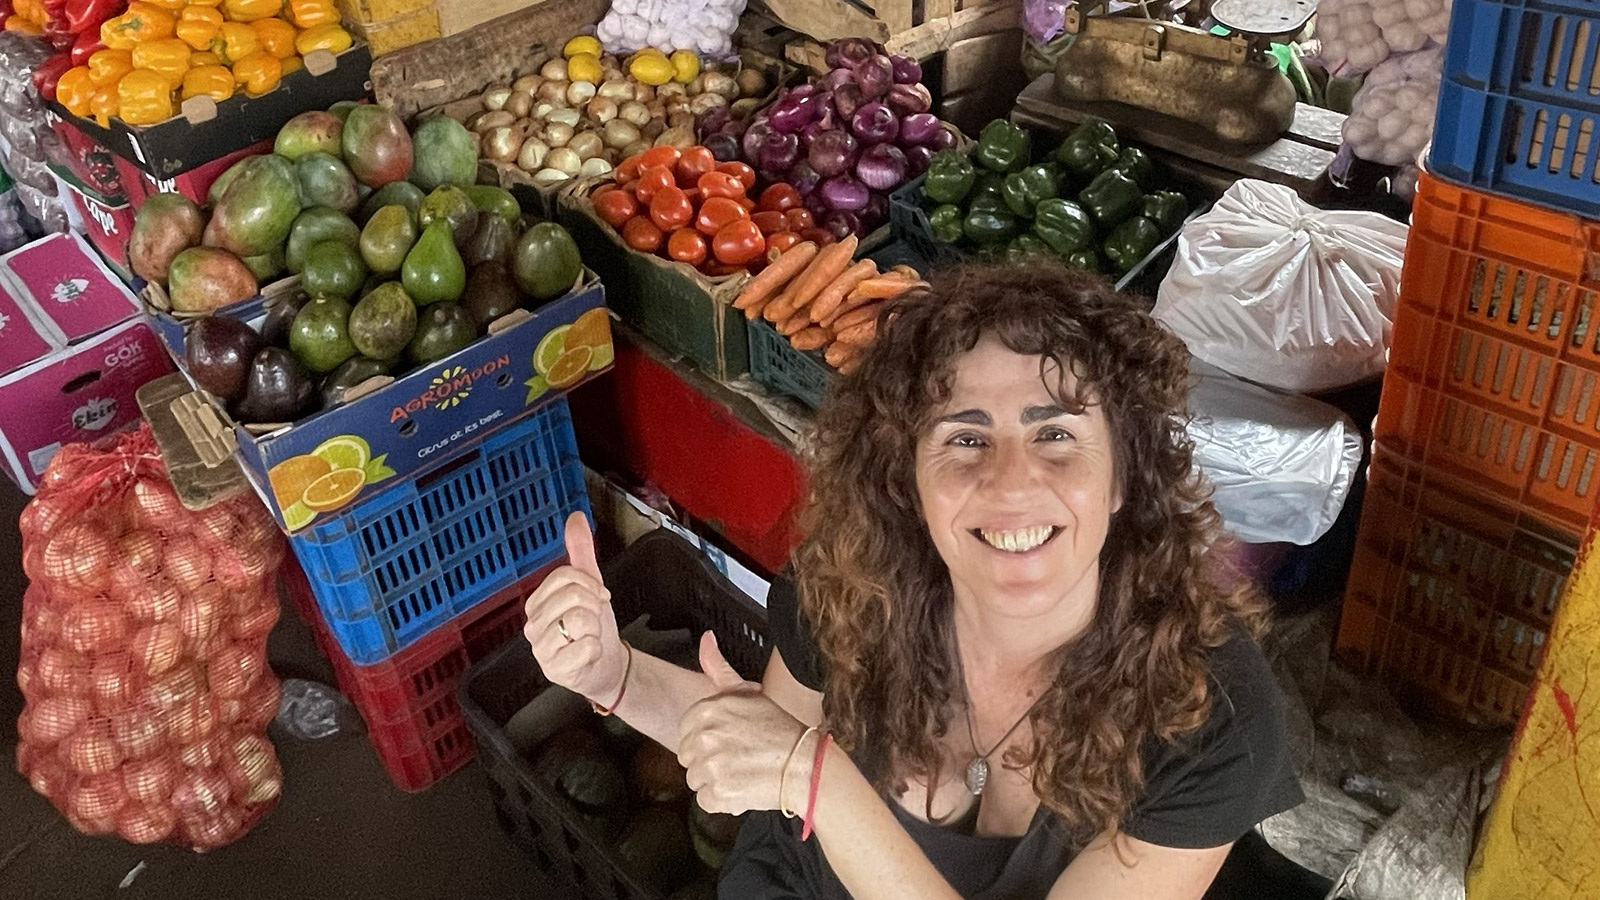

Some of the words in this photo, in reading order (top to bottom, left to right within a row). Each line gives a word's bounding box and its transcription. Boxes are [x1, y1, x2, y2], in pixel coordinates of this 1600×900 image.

[389, 354, 511, 424] AGROMOON
[417, 438, 450, 458] Citrus
[450, 430, 464, 441] at
[479, 409, 504, 425] best
